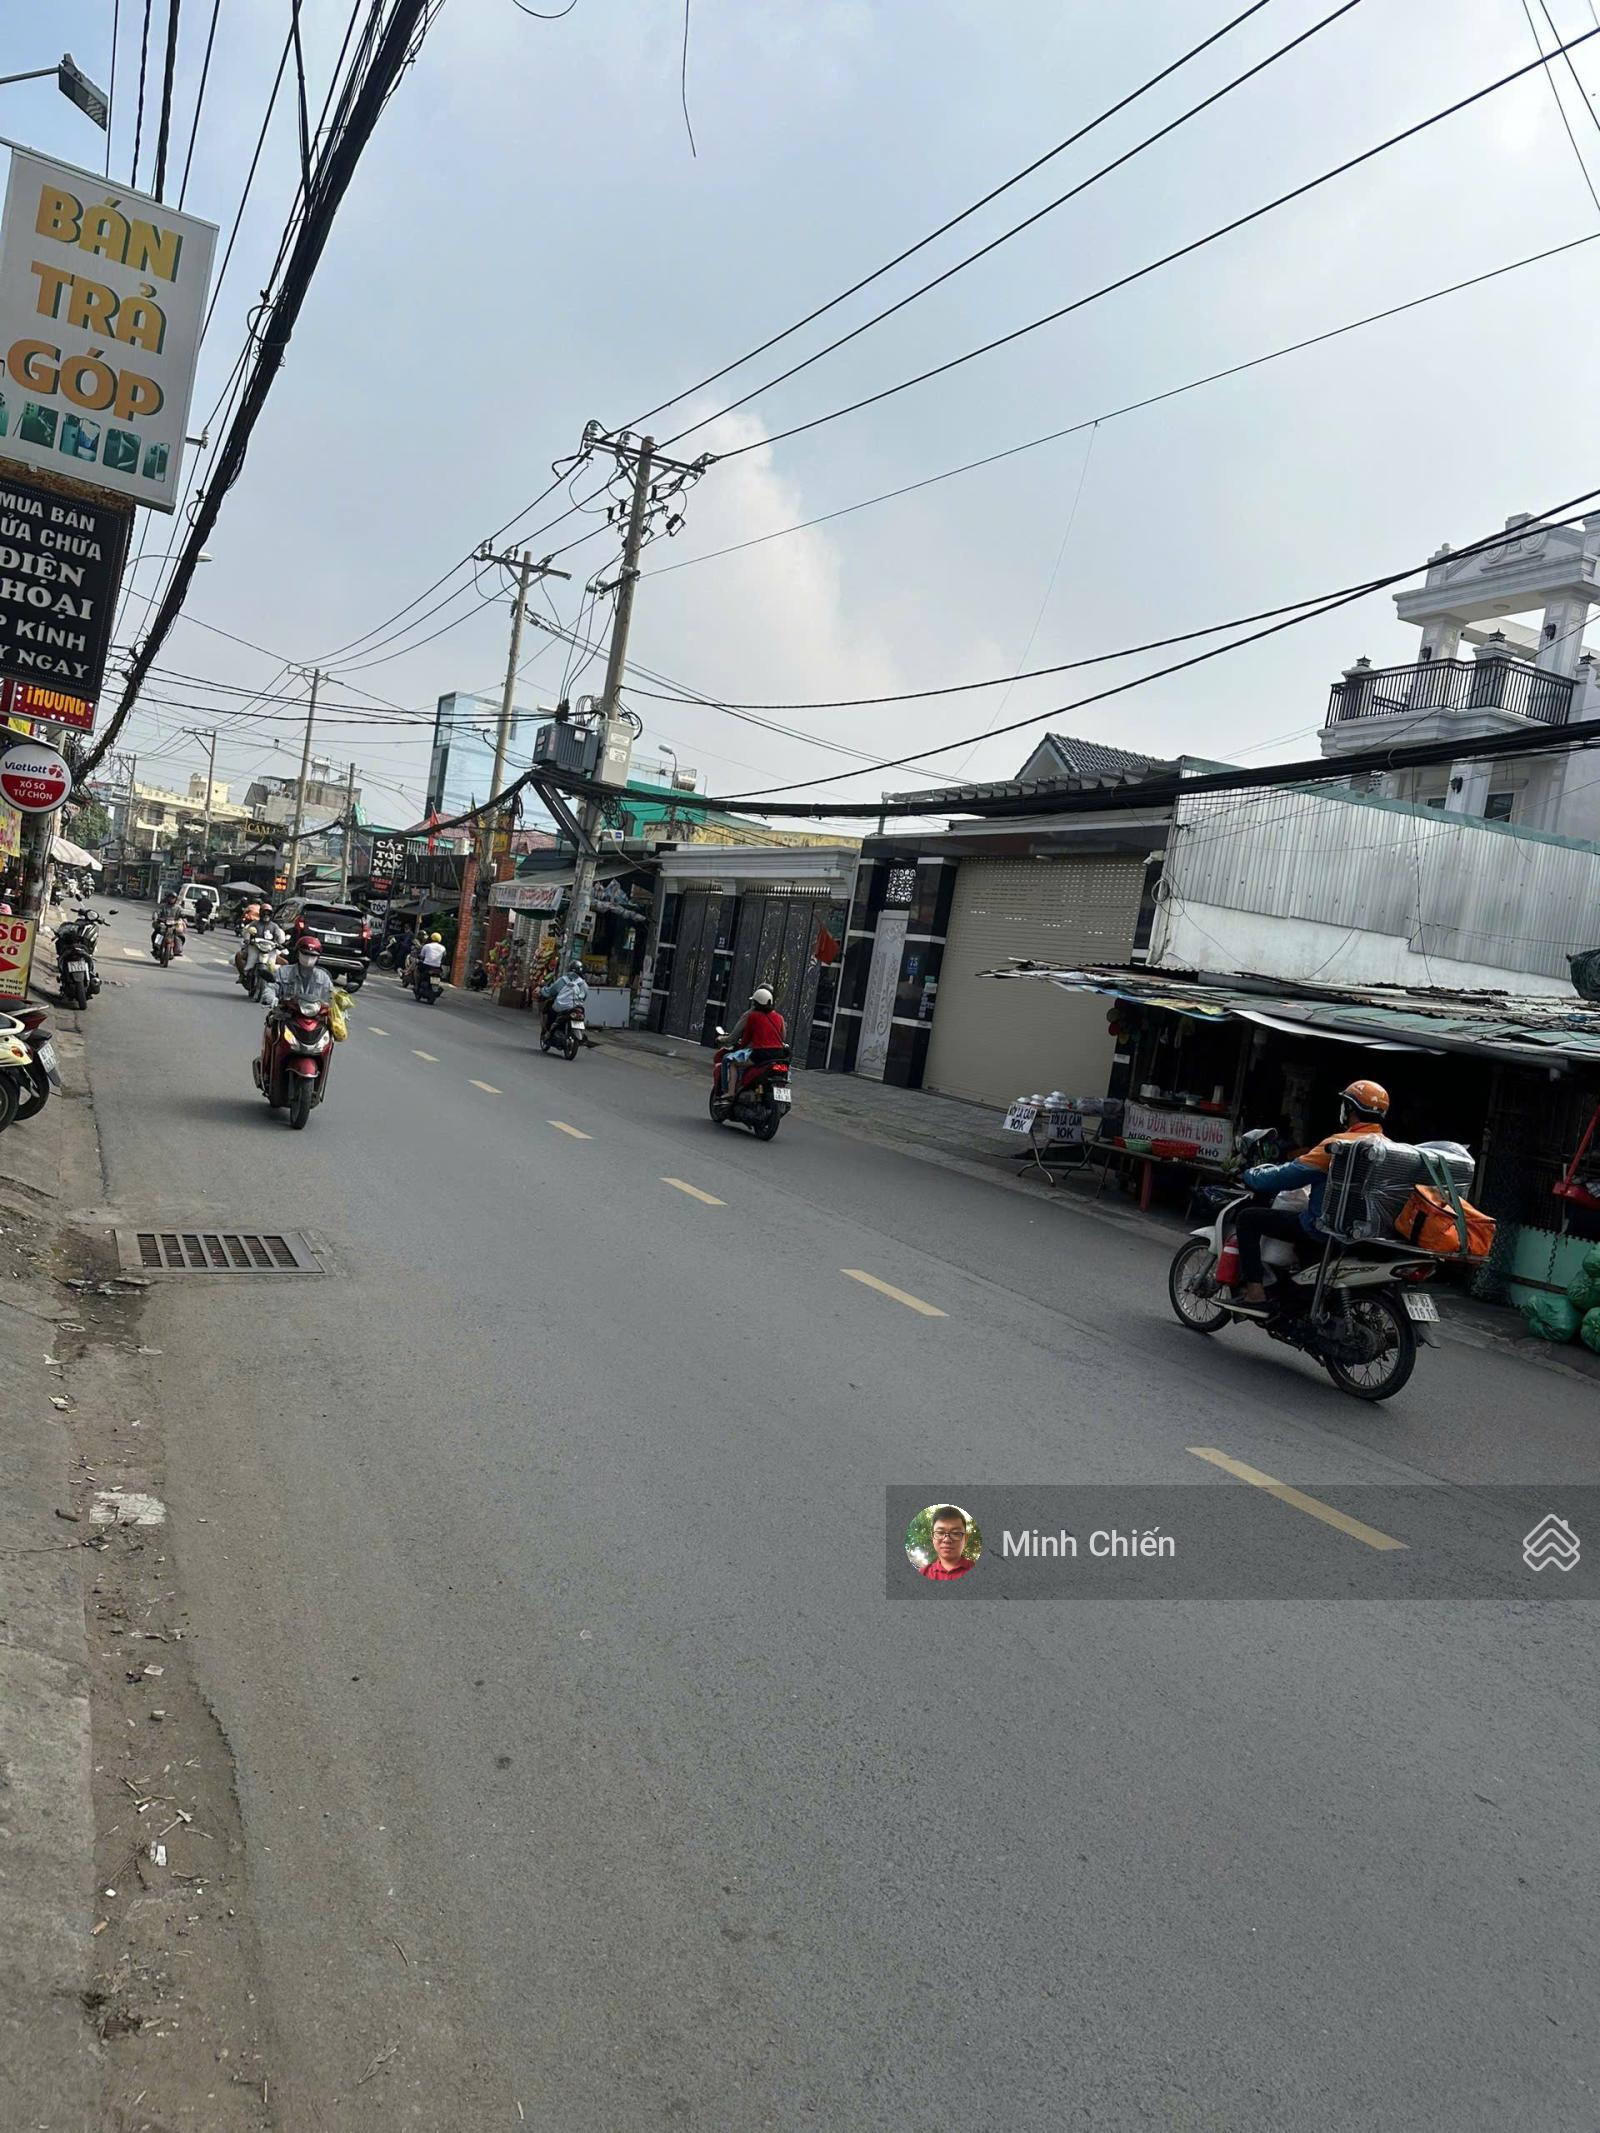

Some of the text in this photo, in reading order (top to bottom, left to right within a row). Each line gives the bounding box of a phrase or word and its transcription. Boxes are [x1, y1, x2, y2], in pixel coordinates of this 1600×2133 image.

[35, 184, 183, 283] BÁN
[31, 260, 167, 354] TRẢ
[7, 339, 164, 421] GÓP
[0, 491, 95, 532] MUA BÁN
[40, 528, 101, 561] CHỮA
[0, 546, 86, 587] ĐIỆN
[16, 620, 86, 652] KÍNH
[17, 649, 90, 678] NGAY
[4, 760, 48, 774] Vietlott
[27, 789, 53, 800] CHỌN
[1010, 1118, 1027, 1131] 10K
[1056, 1126, 1074, 1139] 10K
[1195, 1119, 1224, 1144] LONG
